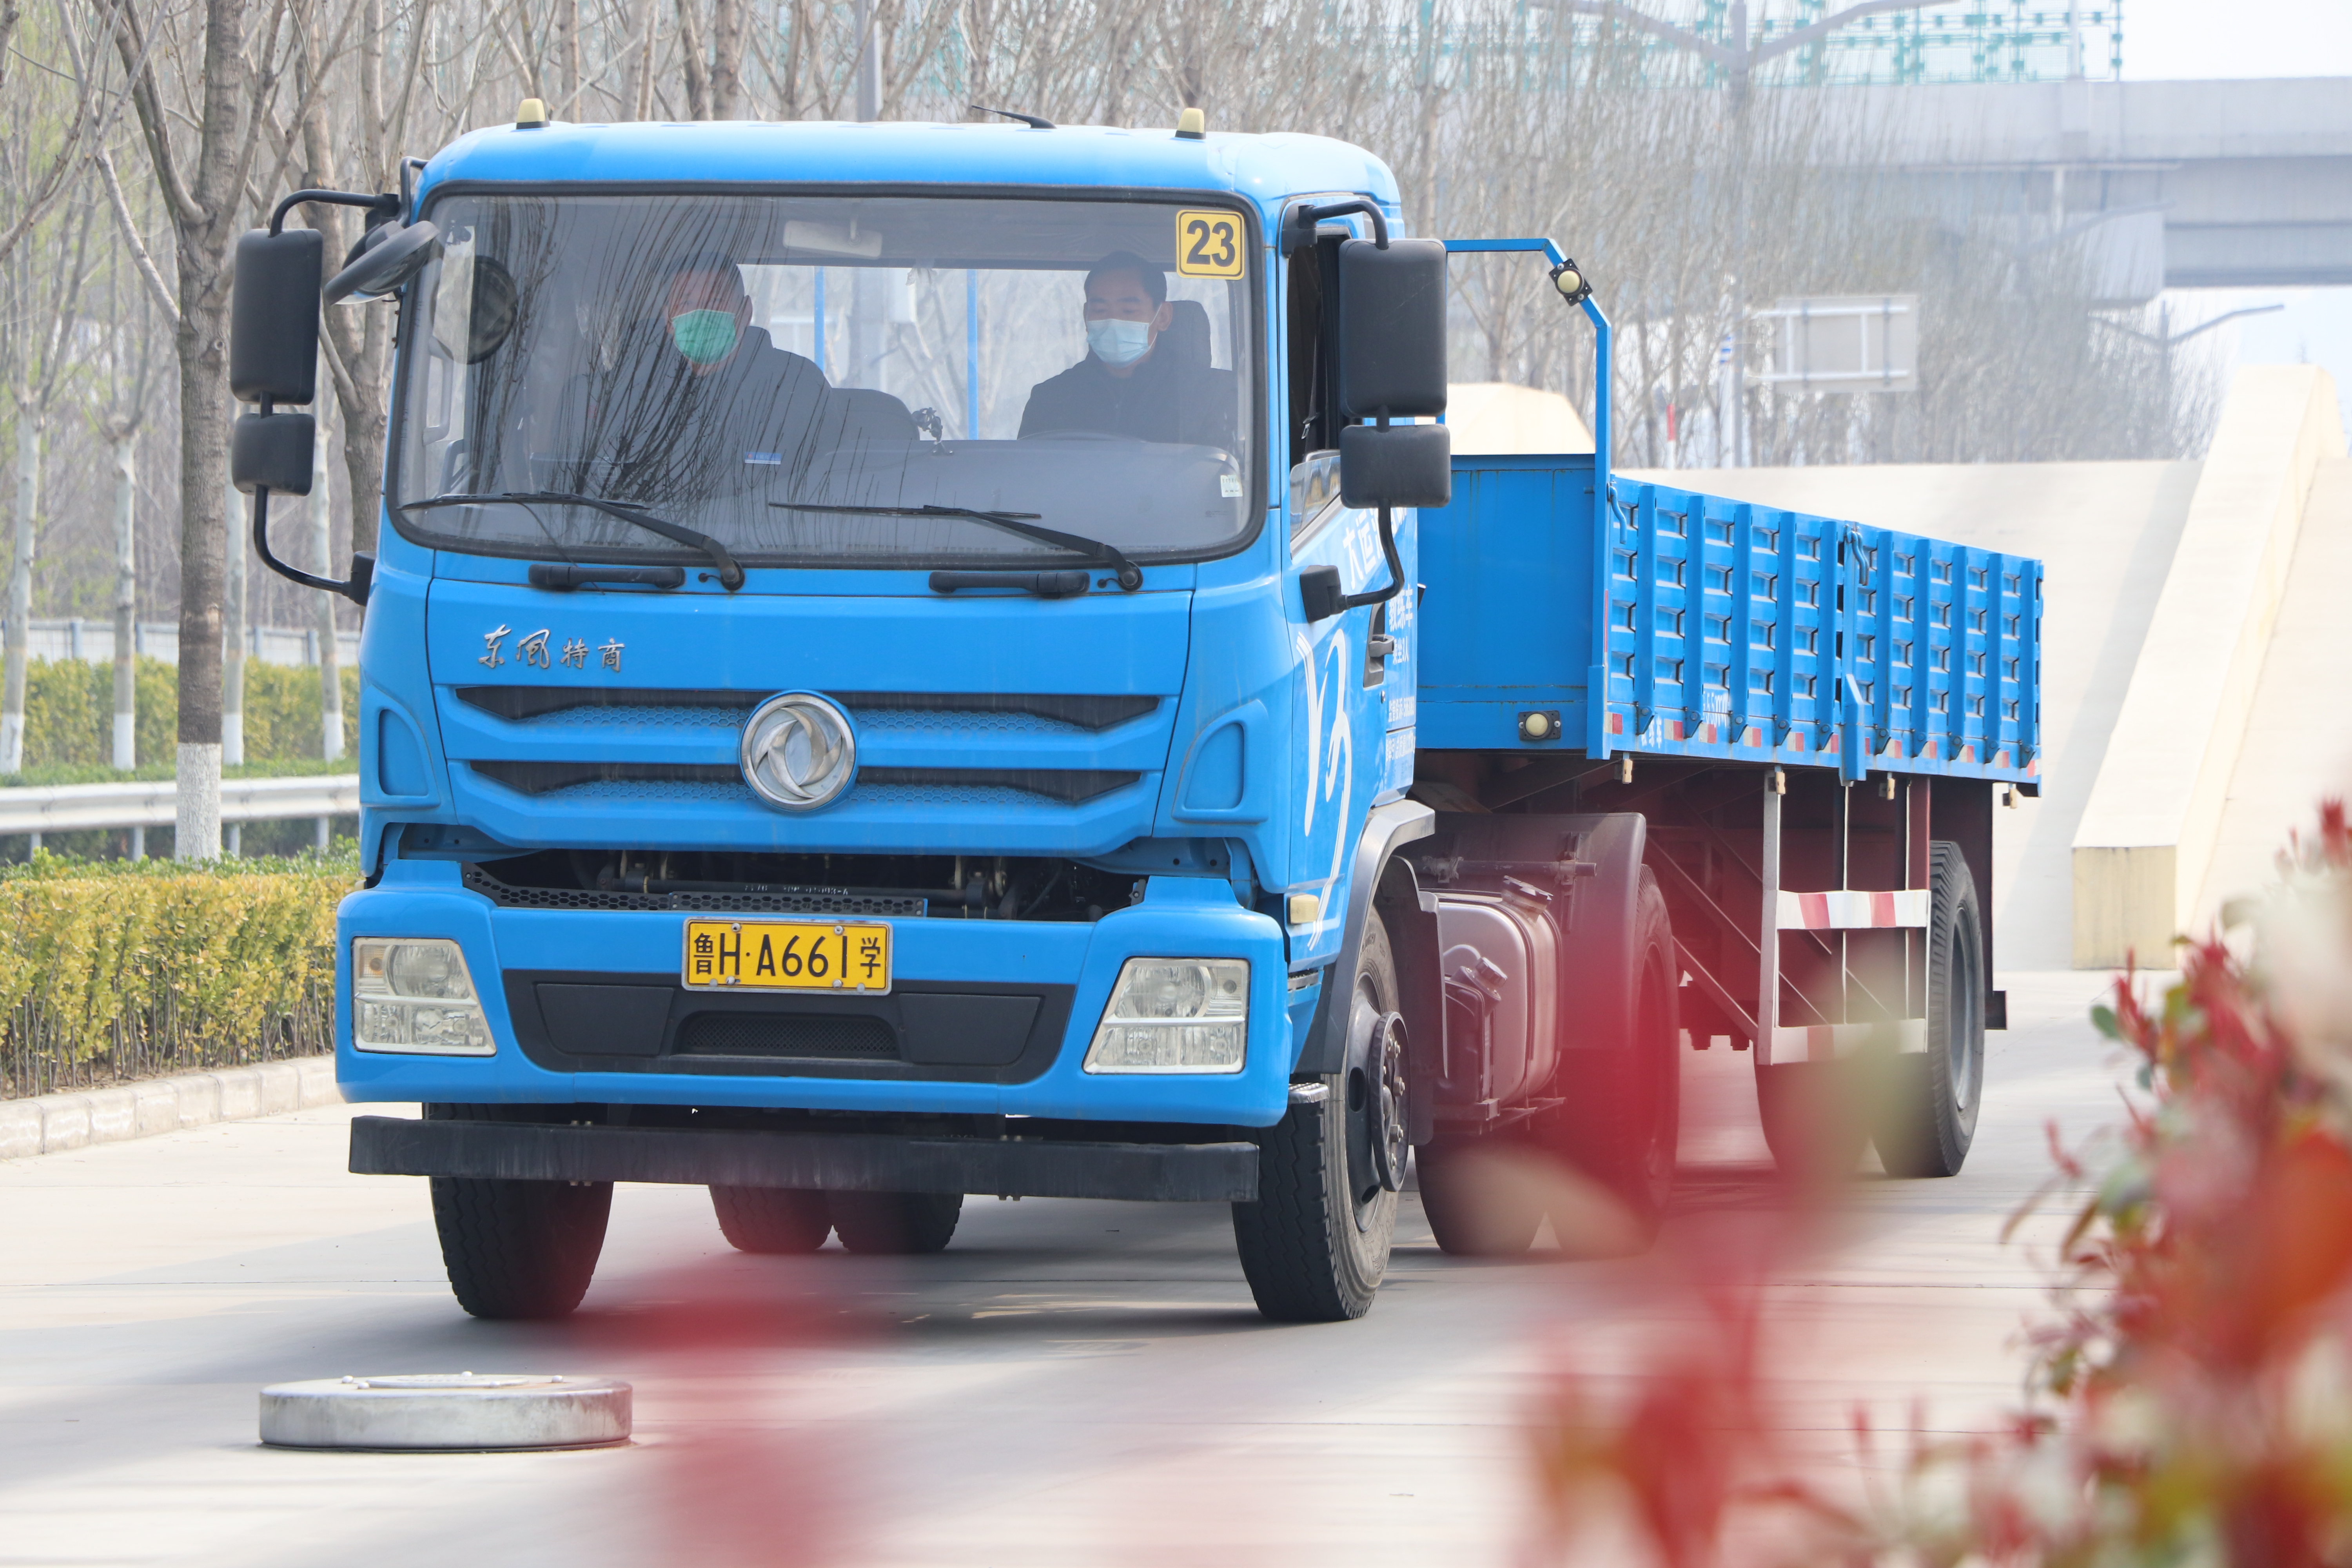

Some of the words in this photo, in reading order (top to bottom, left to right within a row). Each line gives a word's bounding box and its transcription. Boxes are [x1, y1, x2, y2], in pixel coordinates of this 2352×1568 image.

[1186, 220, 1236, 267] 23
[478, 624, 624, 672] 东风特商
[693, 932, 881, 979] 鲁H·A661学
